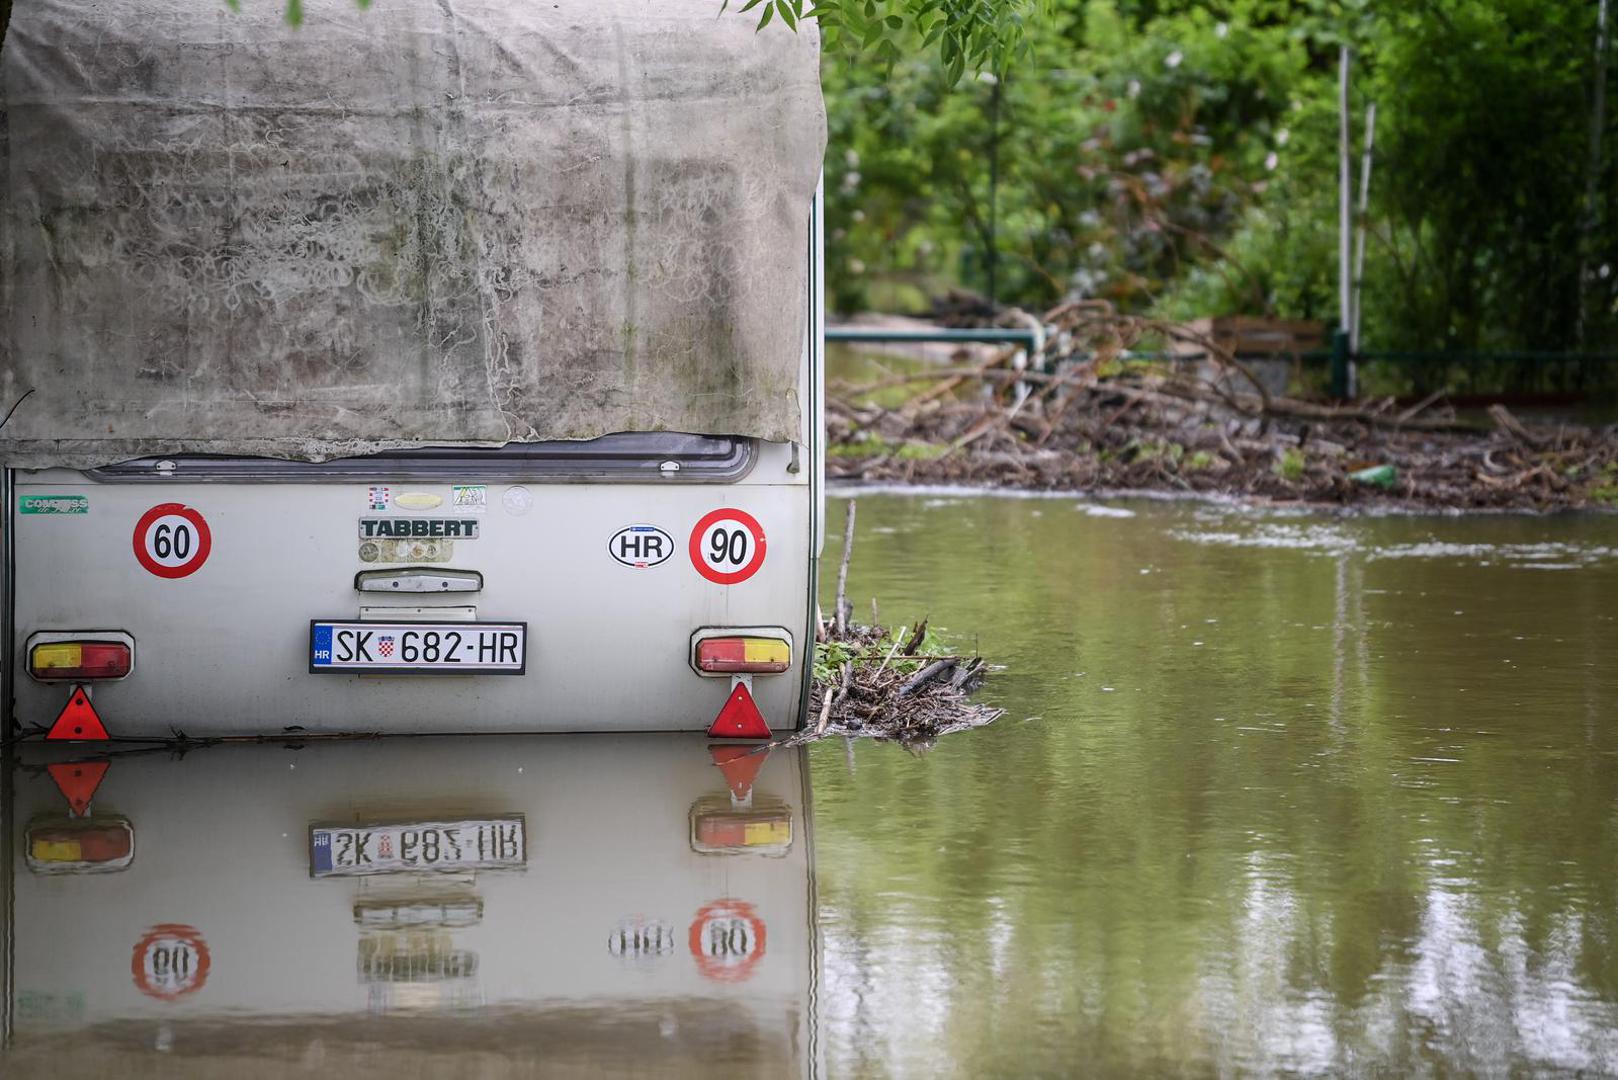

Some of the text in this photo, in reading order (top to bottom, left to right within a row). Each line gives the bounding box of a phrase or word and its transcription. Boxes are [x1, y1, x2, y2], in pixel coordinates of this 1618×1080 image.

[154, 524, 190, 559] 60
[361, 519, 478, 537] TABBERT
[620, 535, 663, 558] HR
[709, 528, 747, 565] 90
[313, 650, 330, 660] HR
[336, 630, 518, 663] SK 682-HR
